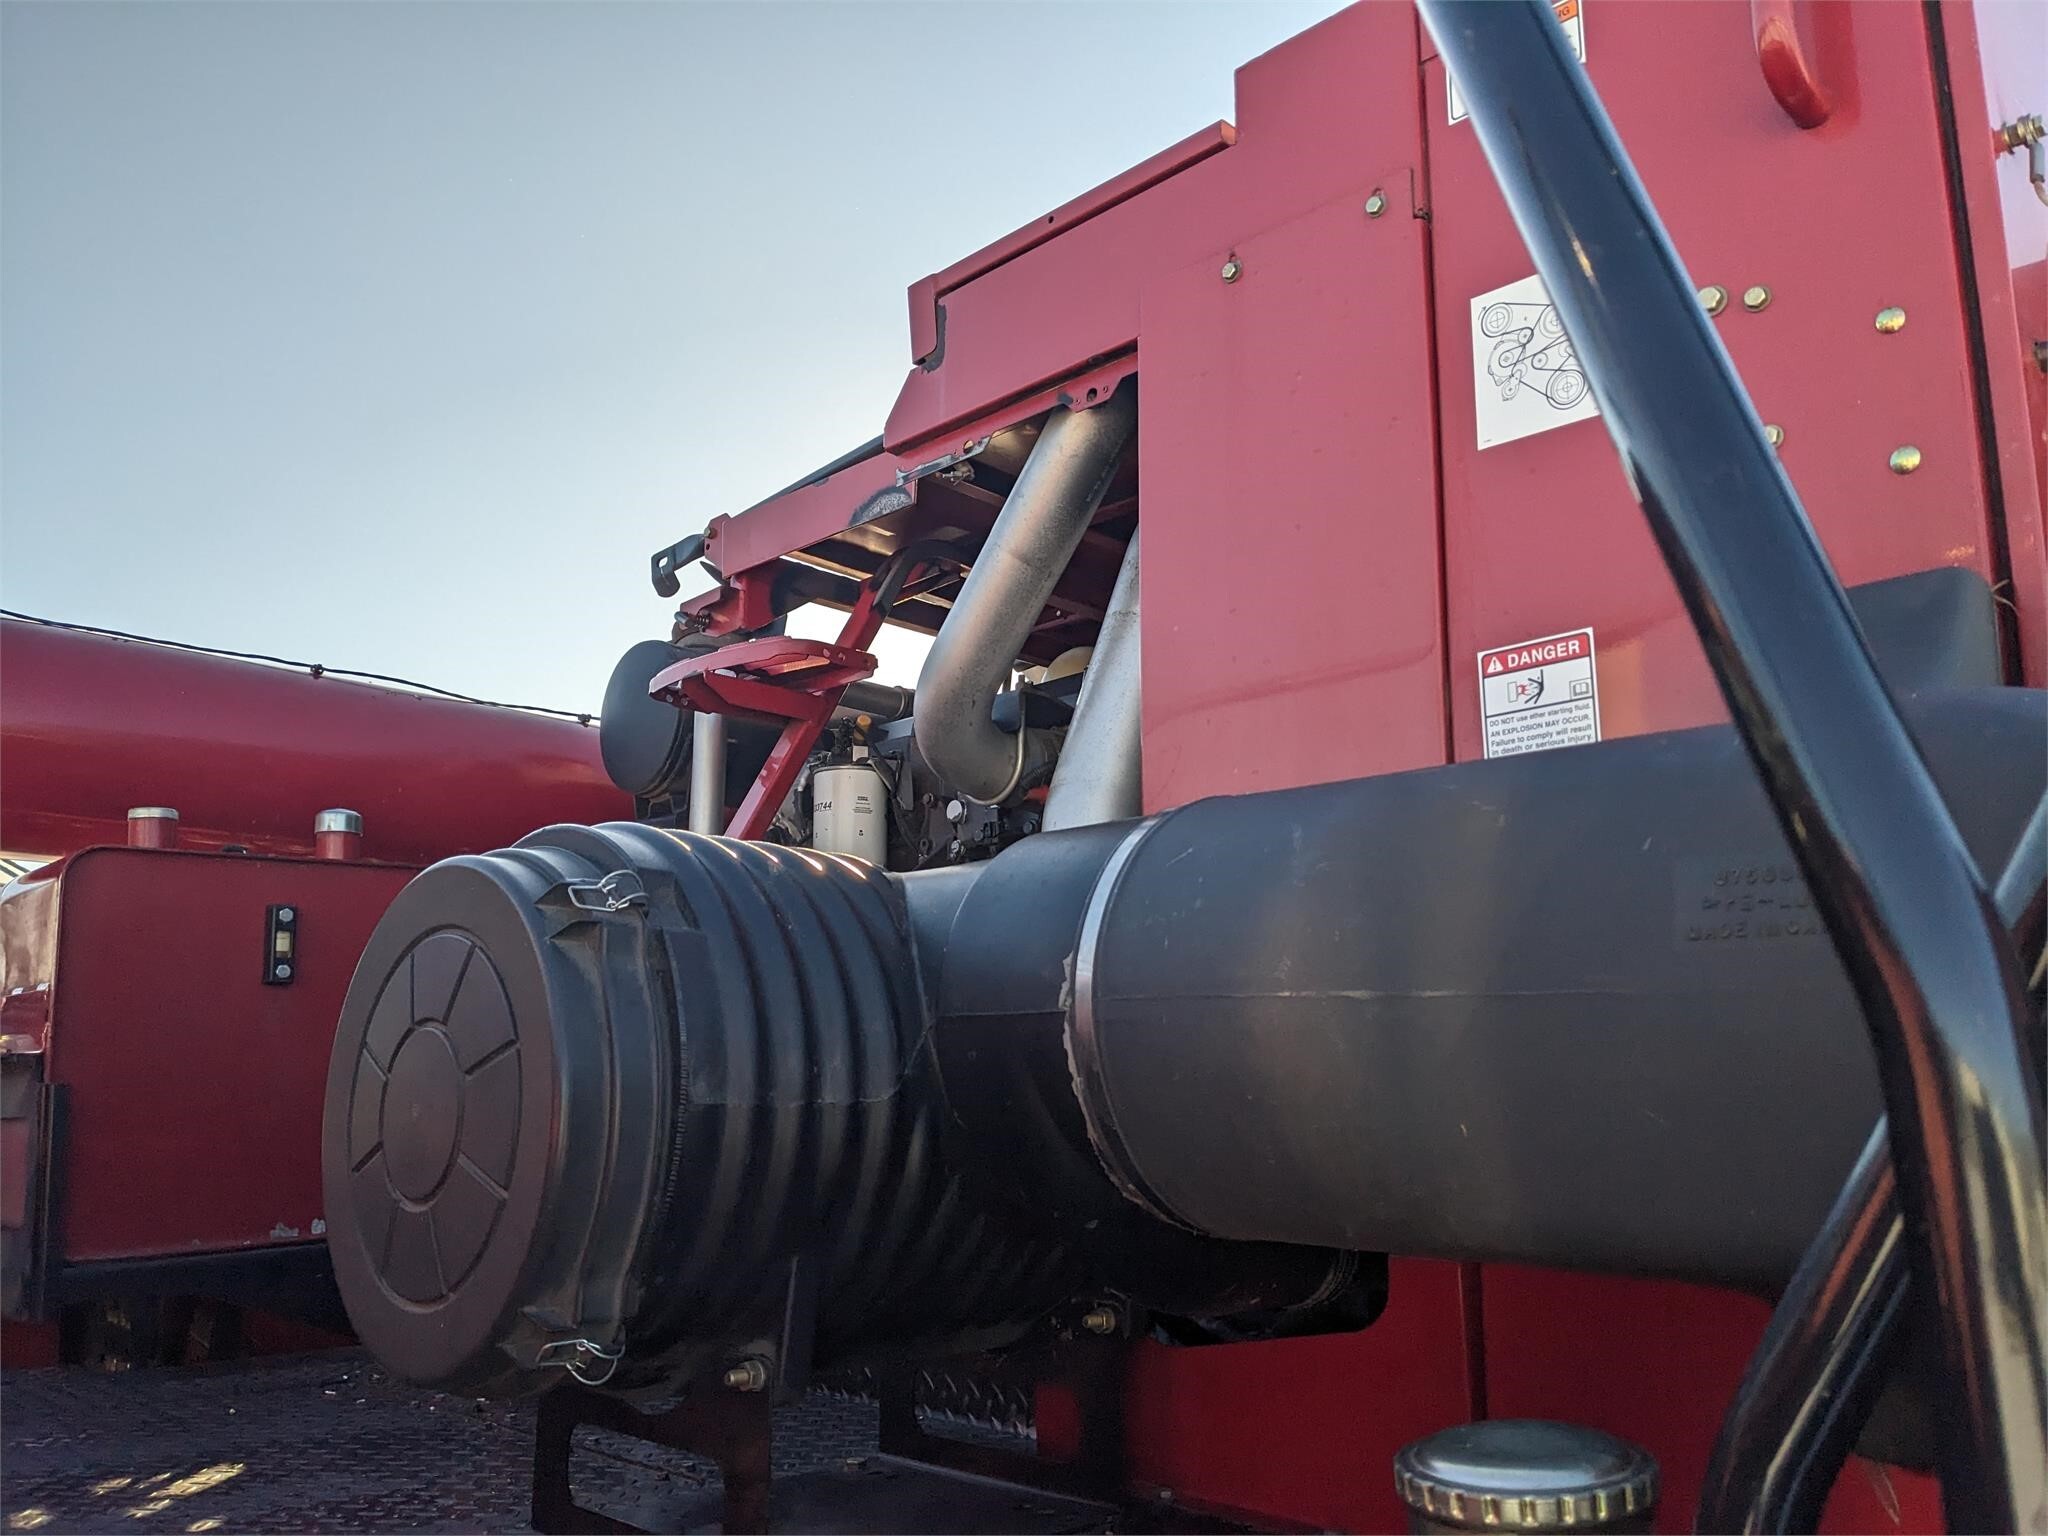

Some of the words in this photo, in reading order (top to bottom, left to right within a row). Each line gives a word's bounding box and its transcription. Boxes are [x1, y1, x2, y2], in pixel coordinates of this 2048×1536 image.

[1507, 639, 1580, 668] DANGER
[1489, 719, 1500, 728] DO
[1500, 716, 1515, 725] NOT
[1547, 706, 1574, 717] starting
[1490, 729, 1501, 738] AN
[1501, 722, 1544, 736] EXPLOSION
[1544, 719, 1560, 729] MAY
[1490, 738, 1516, 748] Failure
[1526, 730, 1554, 742] comply
[1555, 727, 1568, 735] will
[1569, 723, 1592, 734] result
[1500, 745, 1523, 755] death
[1524, 743, 1533, 751] or
[1535, 738, 1566, 749] serious
